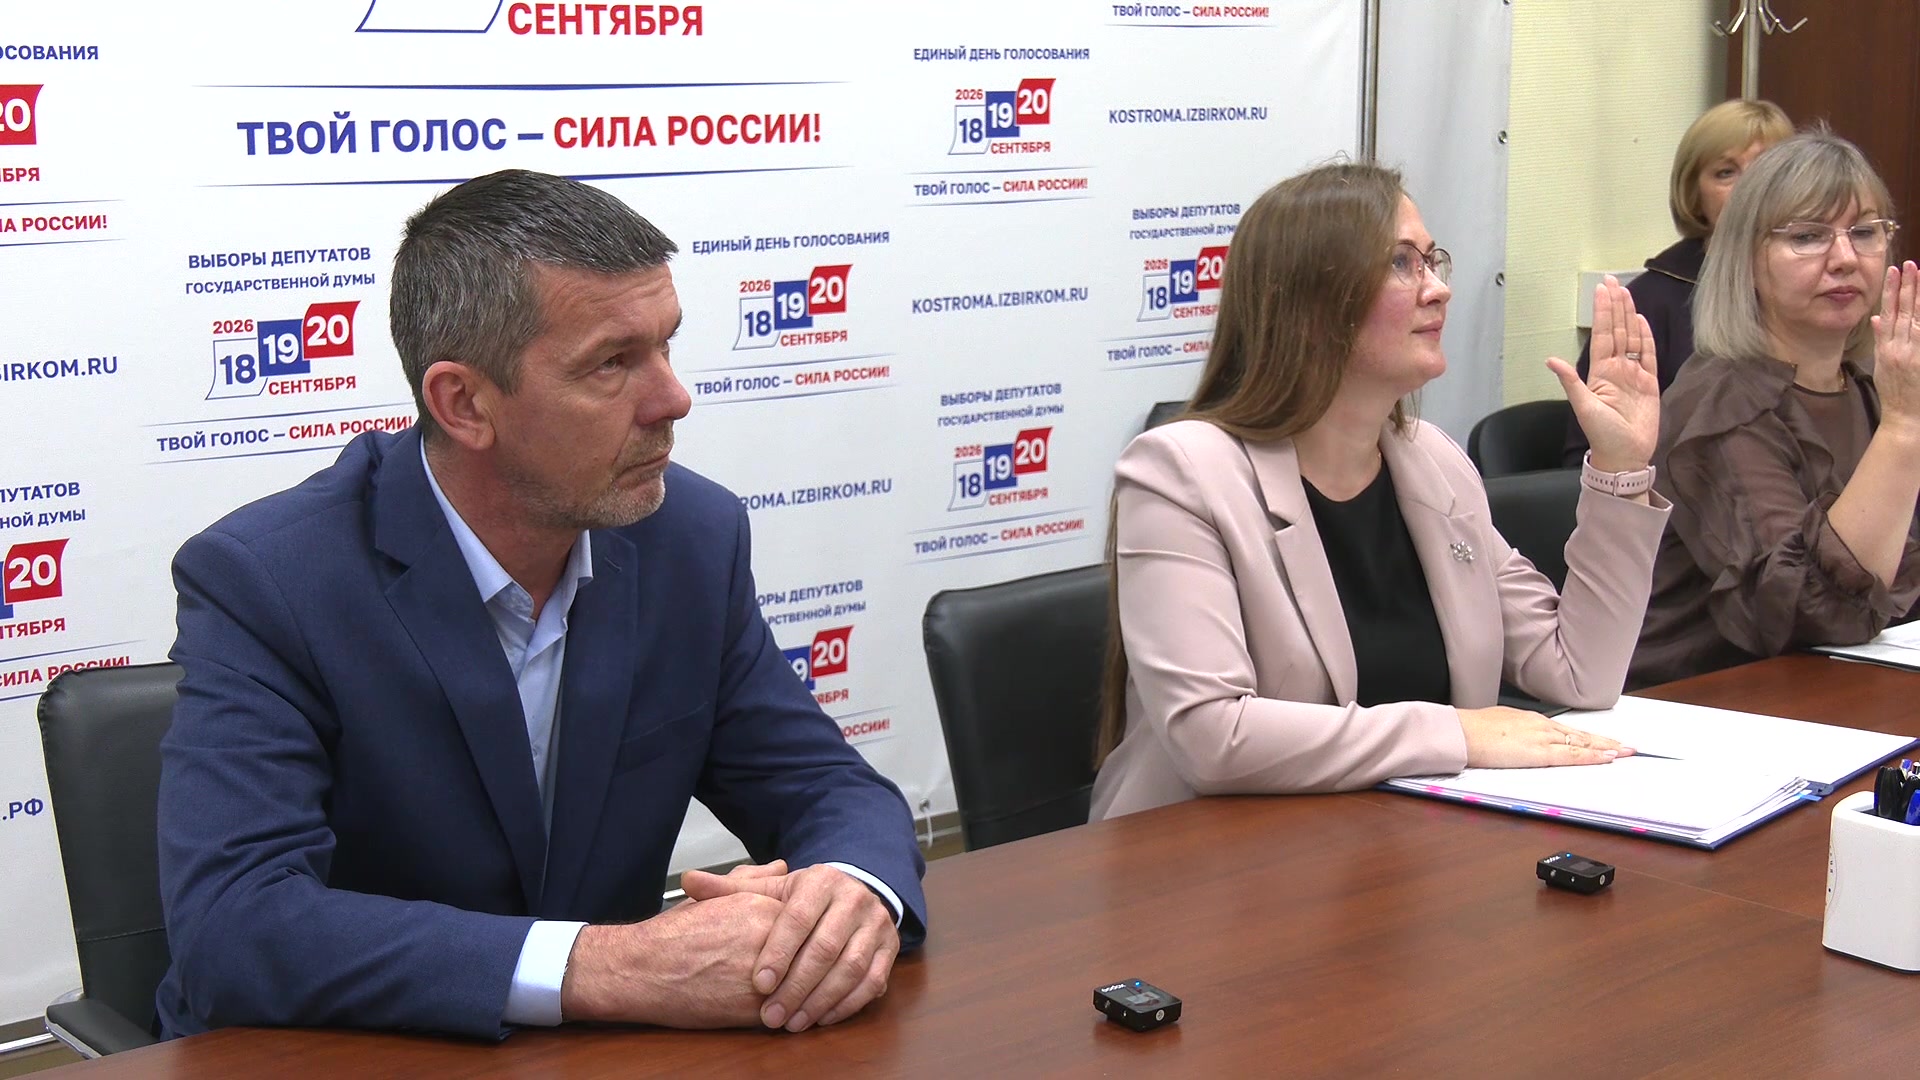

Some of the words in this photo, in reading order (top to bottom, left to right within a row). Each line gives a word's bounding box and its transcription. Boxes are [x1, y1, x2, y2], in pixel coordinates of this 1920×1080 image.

[508, 3, 702, 36] СЕНТЯБРЯ
[1112, 3, 1142, 16] ТВОЙ
[1145, 6, 1180, 17] ГОЛОС
[1193, 6, 1221, 17] СИЛА
[1224, 6, 1269, 17] РОССИИ!
[0, 45, 98, 60] СОВАНИЯ
[914, 46, 966, 61] ЕДИНЫЙ
[969, 49, 1001, 61] ДЕНЬ
[1004, 48, 1089, 59] ГОЛОСОВАНИЯ
[956, 89, 983, 100] 2026
[1019, 89, 1048, 114] 20
[988, 103, 1013, 128] 19
[1109, 107, 1267, 123] KOSTROMA.IZBIRKOM.RU
[237, 111, 356, 155] ТВОЙ
[371, 118, 506, 152] ГОЛОС
[554, 117, 657, 148] СИЛА
[668, 114, 820, 146] РОССИИ!
[959, 118, 983, 143] 18
[991, 142, 1050, 154] СЕНТЯБРЯ
[0, 168, 39, 182] БРЯ
[914, 181, 947, 196] ТВОЙ
[950, 182, 990, 194] ГОЛОС
[1003, 181, 1035, 192] СИЛА
[1038, 178, 1087, 190] РОССИИ!
[22, 215, 107, 231] РОССИИ!
[693, 236, 751, 255] ЕДИНЫЙ
[755, 236, 790, 252] ДЕНЬ
[794, 231, 889, 248] ГОЛОСОВАНИЯ
[189, 252, 266, 268] ВЫБОРЫ
[271, 247, 370, 267] ДЕПУТАТОВ
[1198, 256, 1223, 281] 20
[186, 273, 329, 294] ГОСУДАРСТВЕННОЙ
[333, 273, 375, 288] ДУМЫ
[740, 280, 772, 293] 2026
[811, 276, 843, 304] 20
[1172, 270, 1193, 294] 19
[778, 292, 805, 319] 19
[912, 288, 1088, 314] KOSTROMA.IZBIRKOM.RU
[1147, 286, 1167, 310] 18
[213, 319, 253, 334] 2026
[307, 315, 349, 346] 20
[745, 310, 772, 337] 18
[263, 333, 299, 364] 19
[781, 330, 847, 346] СЕНТЯБРЯ
[0, 356, 117, 381] IRKOM.RU
[220, 354, 256, 385] 18
[695, 377, 732, 395] ТВОЙ
[736, 374, 780, 391] ГОЛОС
[795, 371, 830, 386] СИЛА
[834, 366, 889, 382] РОССИИ!
[269, 376, 356, 395] СЕНТЯБРЯ
[941, 391, 992, 406] ВЫБОРЫ
[995, 383, 1062, 402] ДЕПУТАТОВ
[937, 407, 1033, 427] ГОСУДАРСТВЕННОЙ
[157, 431, 205, 451] ТВОЙ
[211, 429, 269, 446] ГОЛОС
[289, 423, 335, 439] СИЛА
[1016, 438, 1045, 465] 20
[987, 455, 1011, 481] 19
[958, 473, 981, 498] 18
[989, 487, 1048, 505] СЕНТЯБРЯ
[38, 509, 85, 527] ДУМЫ
[914, 536, 947, 554] ТВОЙ
[950, 534, 988, 550] ГОЛОС
[1001, 527, 1033, 542] СИЛА
[9, 555, 56, 589] 20
[789, 580, 863, 603] ДЕПУТАТОВ
[763, 607, 832, 625] РСТВЕННОЙ
[814, 638, 845, 667] 20
[789, 658, 808, 682] 9
[814, 688, 849, 704] ЯБРЯ
[841, 719, 889, 738] ОССИИ!
